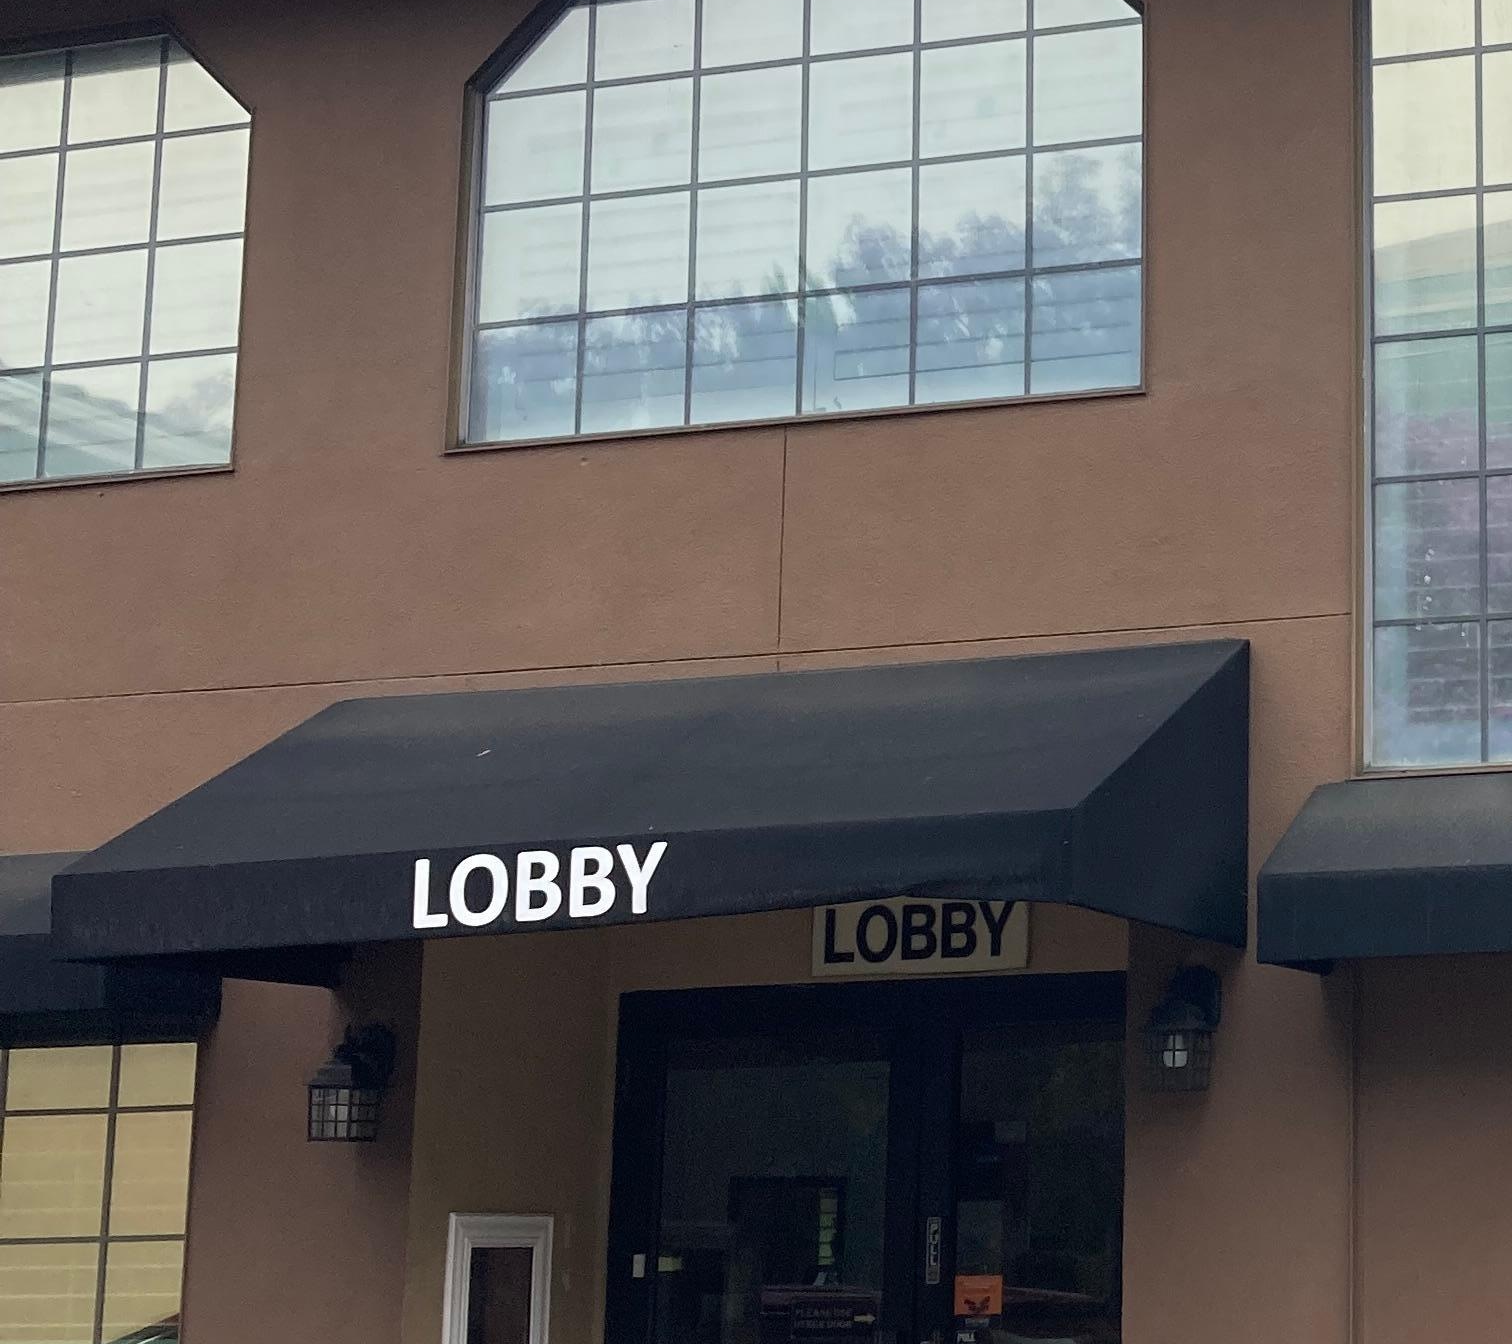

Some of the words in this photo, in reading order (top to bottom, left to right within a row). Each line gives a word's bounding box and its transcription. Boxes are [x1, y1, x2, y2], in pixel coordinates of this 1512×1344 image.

[412, 840, 669, 930] LOBBY
[824, 900, 1015, 964] LOBBY
[929, 1223, 939, 1265] PULL
